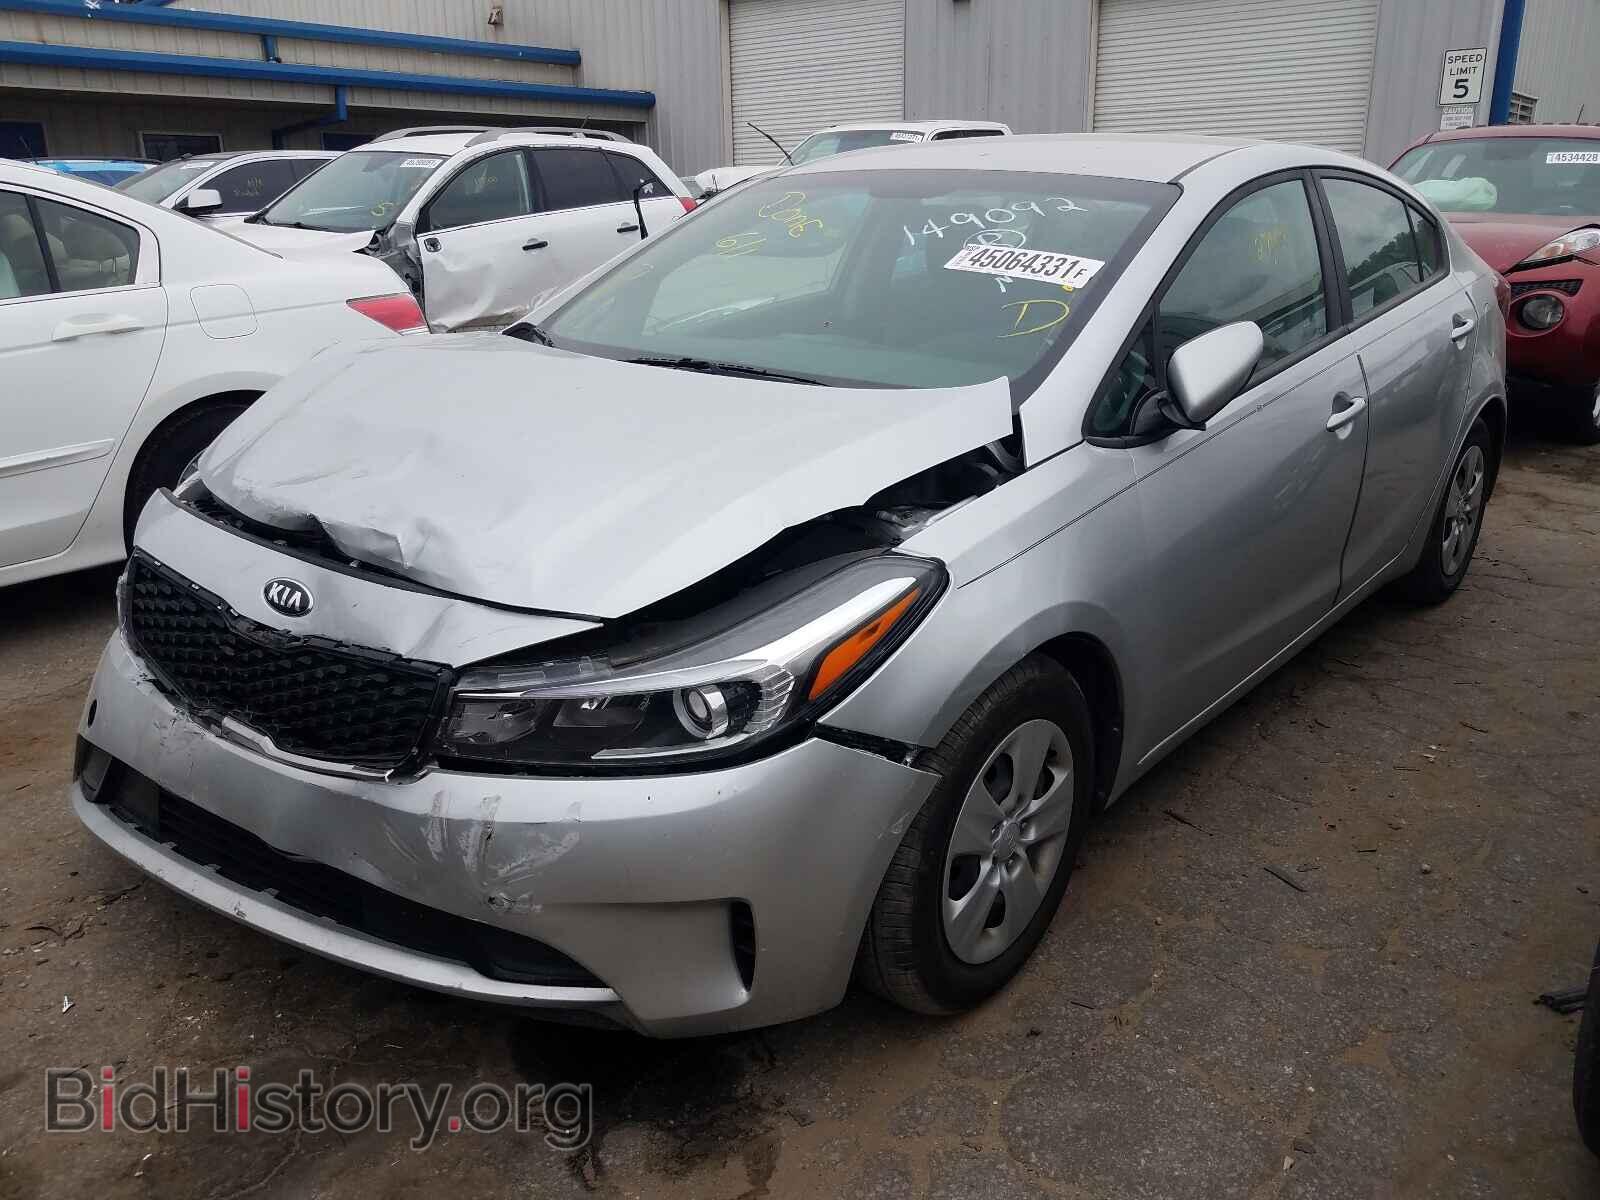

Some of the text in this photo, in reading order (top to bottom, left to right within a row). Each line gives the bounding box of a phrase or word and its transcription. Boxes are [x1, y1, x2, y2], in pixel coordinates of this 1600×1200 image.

[1447, 54, 1483, 64] SPEED
[1449, 66, 1478, 76] LIMIT
[1452, 78, 1469, 98] 5
[903, 197, 1088, 246] 149092
[967, 248, 1081, 279] 45064331
[1072, 268, 1088, 280] F
[268, 582, 302, 610] KIA
